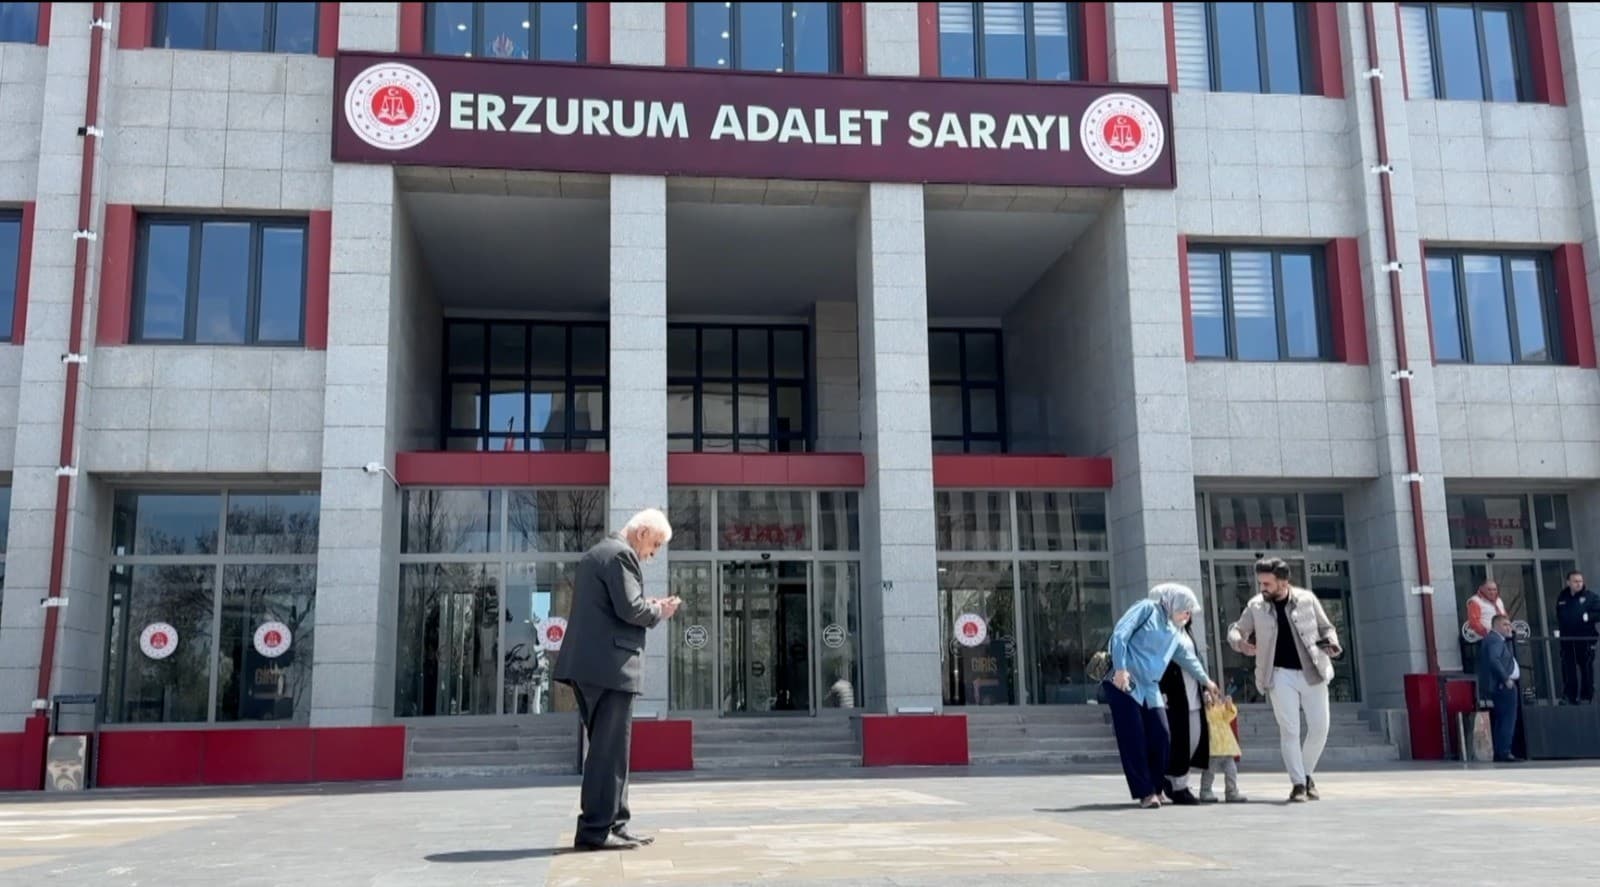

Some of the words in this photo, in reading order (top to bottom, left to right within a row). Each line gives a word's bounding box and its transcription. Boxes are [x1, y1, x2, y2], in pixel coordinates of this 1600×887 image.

[449, 91, 690, 140] ERZURUM
[710, 105, 888, 147] ADALET
[908, 111, 1071, 152] SARAYI
